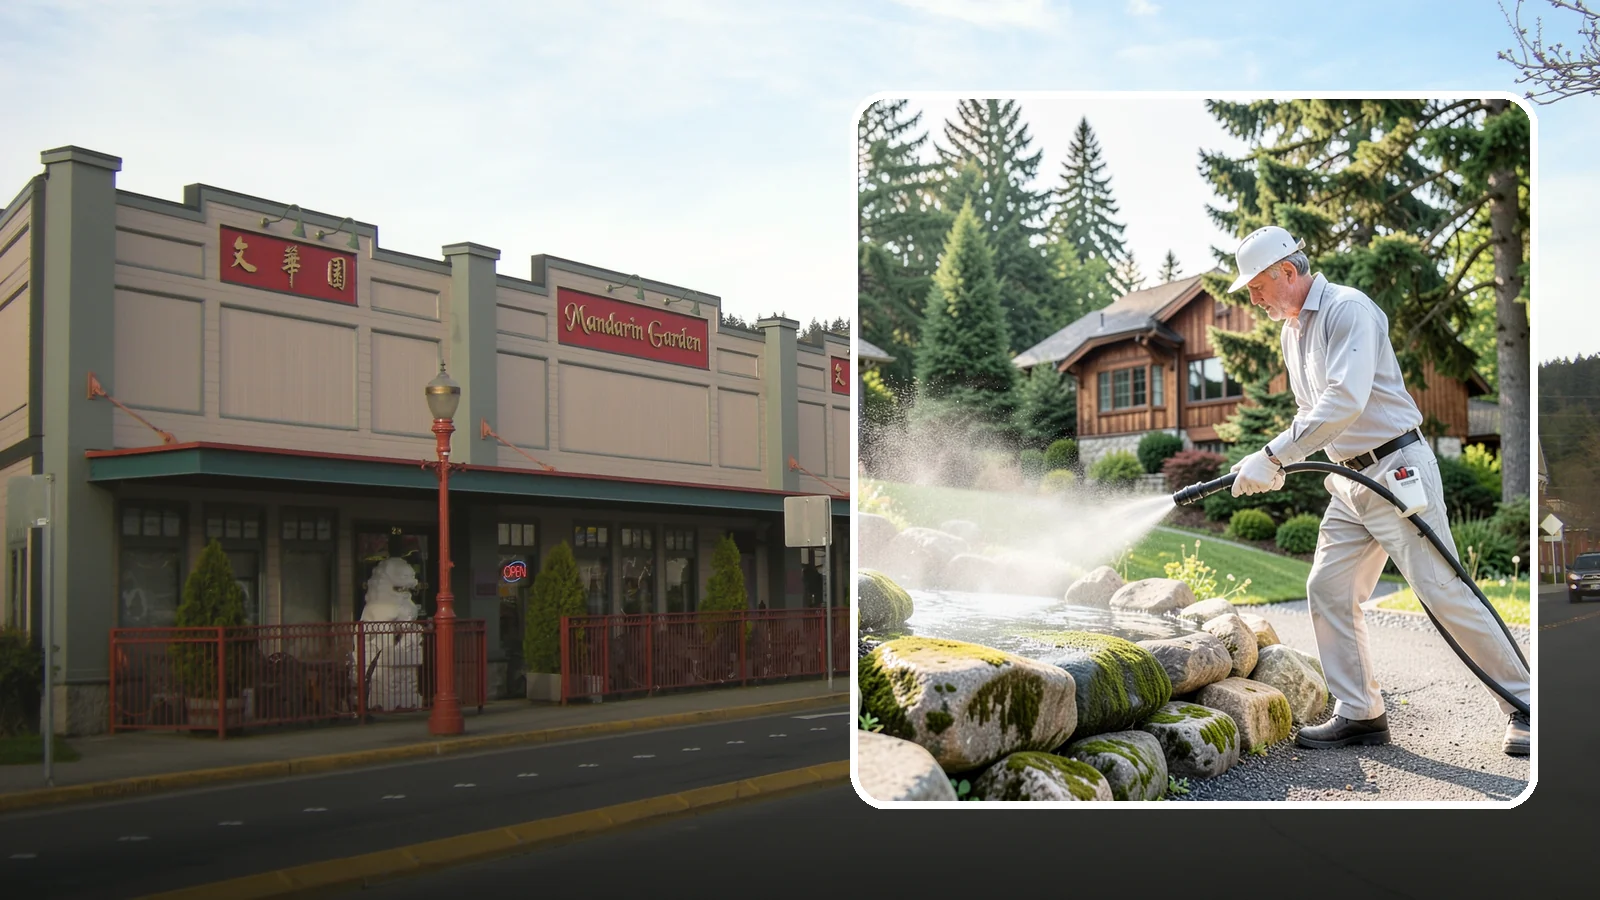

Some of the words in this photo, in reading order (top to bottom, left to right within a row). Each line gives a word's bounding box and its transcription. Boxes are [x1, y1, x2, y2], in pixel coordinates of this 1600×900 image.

[231, 236, 346, 291] 文華園
[564, 302, 644, 341] Mandarin
[648, 320, 702, 352] Garden
[835, 363, 846, 386] 文
[503, 565, 527, 578] OPEN
